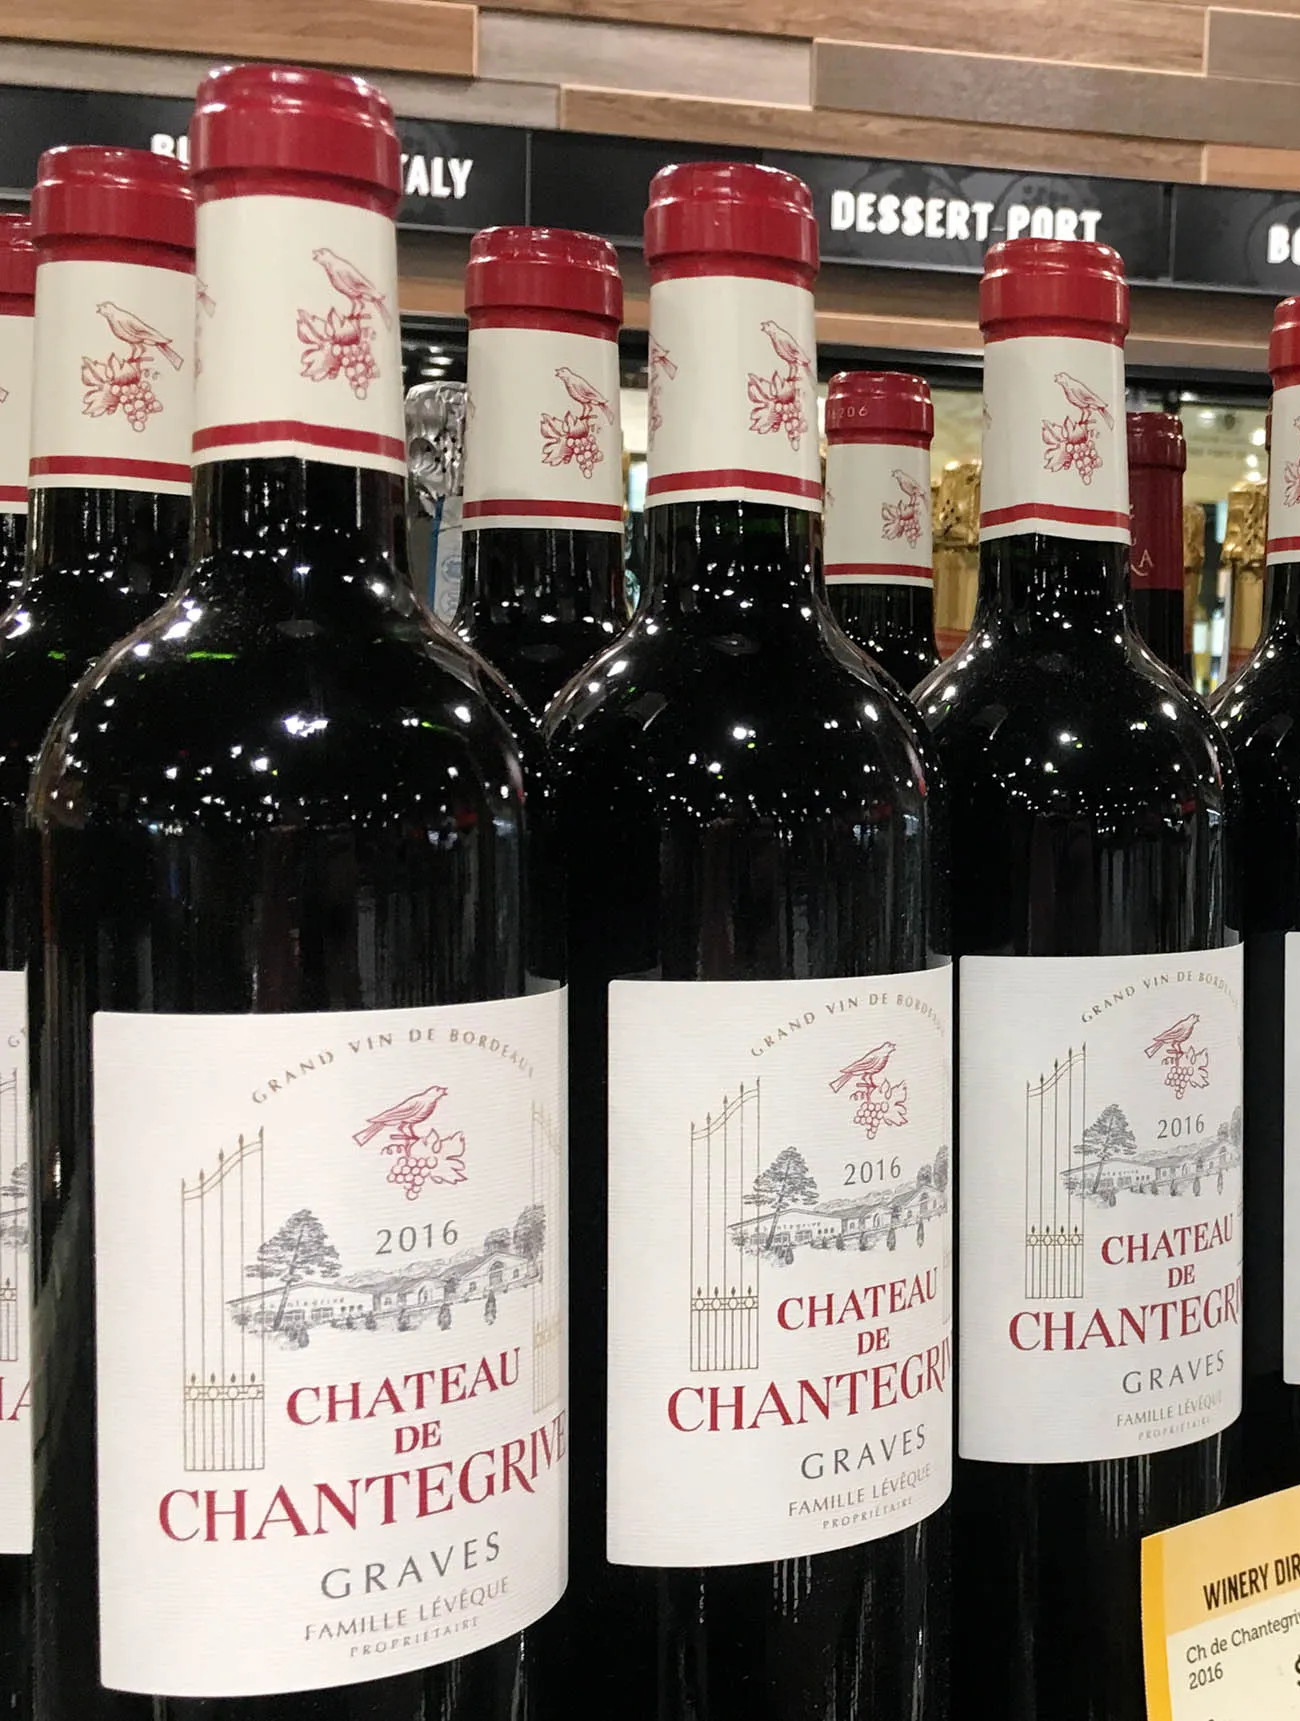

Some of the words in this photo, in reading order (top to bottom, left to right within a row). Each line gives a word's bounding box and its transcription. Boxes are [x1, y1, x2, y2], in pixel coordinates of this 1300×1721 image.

[831, 189, 994, 241] DESSERT
[1007, 204, 1102, 242] PORT
[1081, 985, 1136, 1024] GRAND
[1143, 973, 1170, 990] VIN
[1176, 970, 1193, 983] DE
[751, 1011, 816, 1058] GRAND
[825, 995, 860, 1016] VIN
[869, 992, 889, 1006] DE
[896, 993, 946, 1038] BORDE
[251, 1049, 335, 1106] GRAND
[347, 1032, 394, 1056] VIN
[408, 1027, 437, 1044] DE
[1157, 1113, 1206, 1141] 2016
[843, 1155, 902, 1187] 2016
[375, 1219, 460, 1257] 2016
[1101, 1212, 1234, 1266] CHATEAU
[776, 1266, 939, 1331] CHATEAU
[1167, 1263, 1196, 1289] DE
[856, 1326, 892, 1356] DE
[286, 1347, 522, 1426] CHATEAU
[1122, 1349, 1226, 1395] GRAVES
[394, 1420, 443, 1455] DE
[1116, 1406, 1175, 1428] FAMILLE
[800, 1423, 927, 1481] GRAVES
[158, 1408, 567, 1543] CHANTEGRIVE
[788, 1487, 866, 1517] FAMILLE
[320, 1530, 502, 1600] GRAVES
[1203, 1562, 1271, 1612] WINERY
[304, 1607, 408, 1642] FAMILLE
[1186, 1643, 1208, 1664] Ch
[1210, 1636, 1229, 1656] de
[1187, 1661, 1224, 1690] 2016
